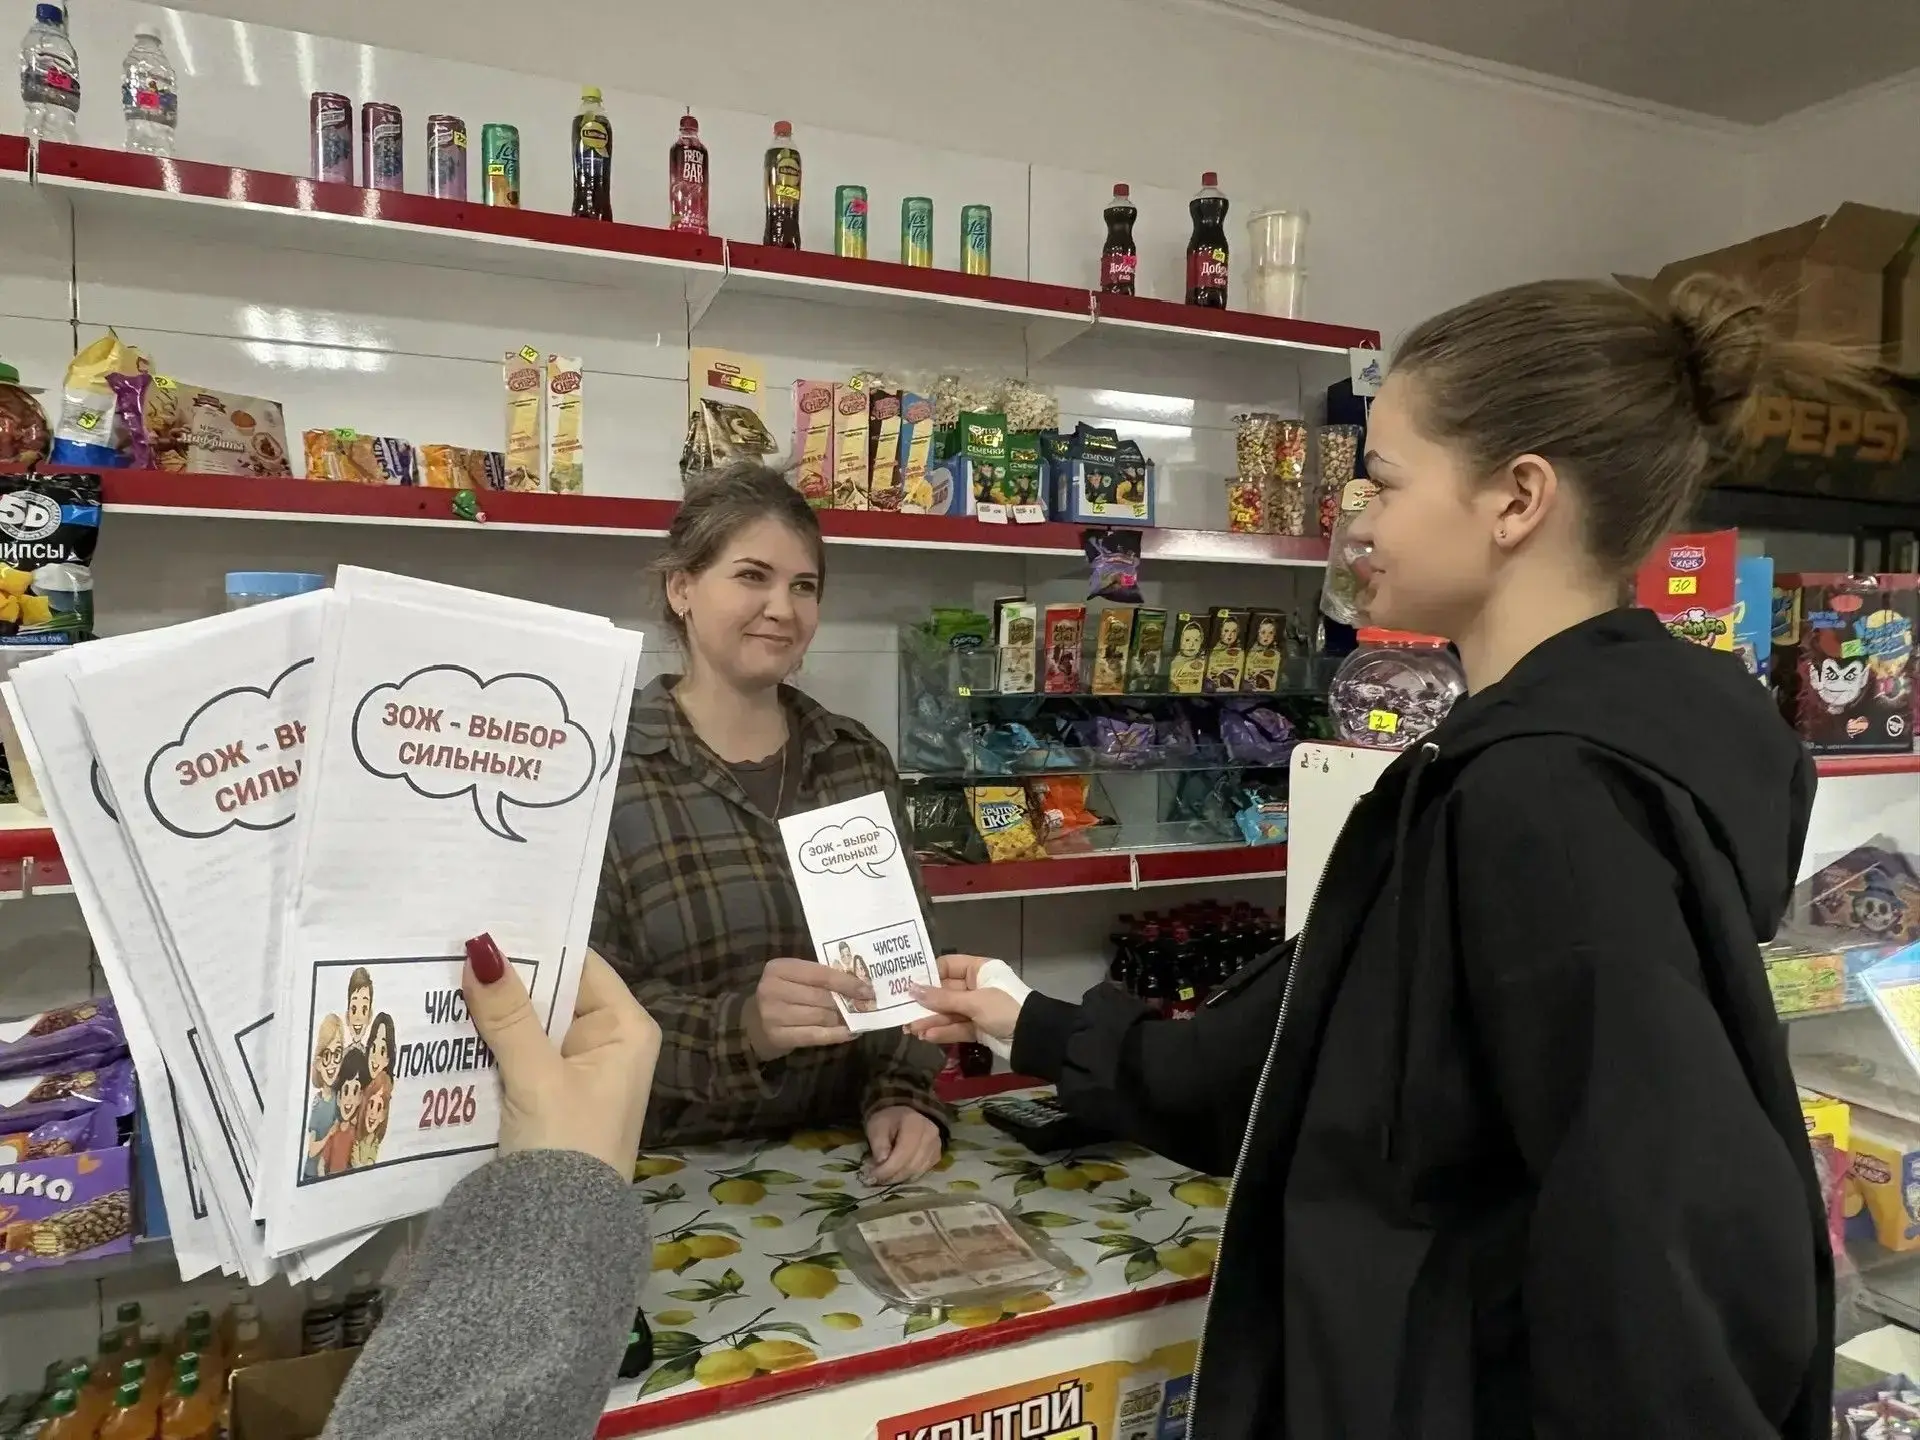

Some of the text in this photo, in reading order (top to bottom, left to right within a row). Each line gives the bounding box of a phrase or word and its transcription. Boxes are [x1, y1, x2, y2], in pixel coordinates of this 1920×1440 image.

[683, 163, 704, 183] BAR
[0, 543, 65, 560] ИПСЫ
[1671, 579, 1692, 593] 30
[381, 702, 444, 734] ЗОЖ
[468, 714, 568, 751] ВЫБОР
[175, 740, 251, 786] ЗОЖ
[398, 741, 543, 782] СИЛЬНЫХ!
[214, 759, 303, 814] СИЛЬ
[808, 841, 833, 857] ЗОЖ
[843, 831, 881, 849] ВЫБОР
[821, 845, 879, 867] СИЛЬНЫХ!
[872, 934, 911, 957] ЧИСТОЕ
[869, 950, 926, 980] ПОКОЛЕНИЕ
[888, 975, 914, 996] 2026
[424, 988, 474, 1025] ЧИС
[418, 1084, 477, 1130] 2026
